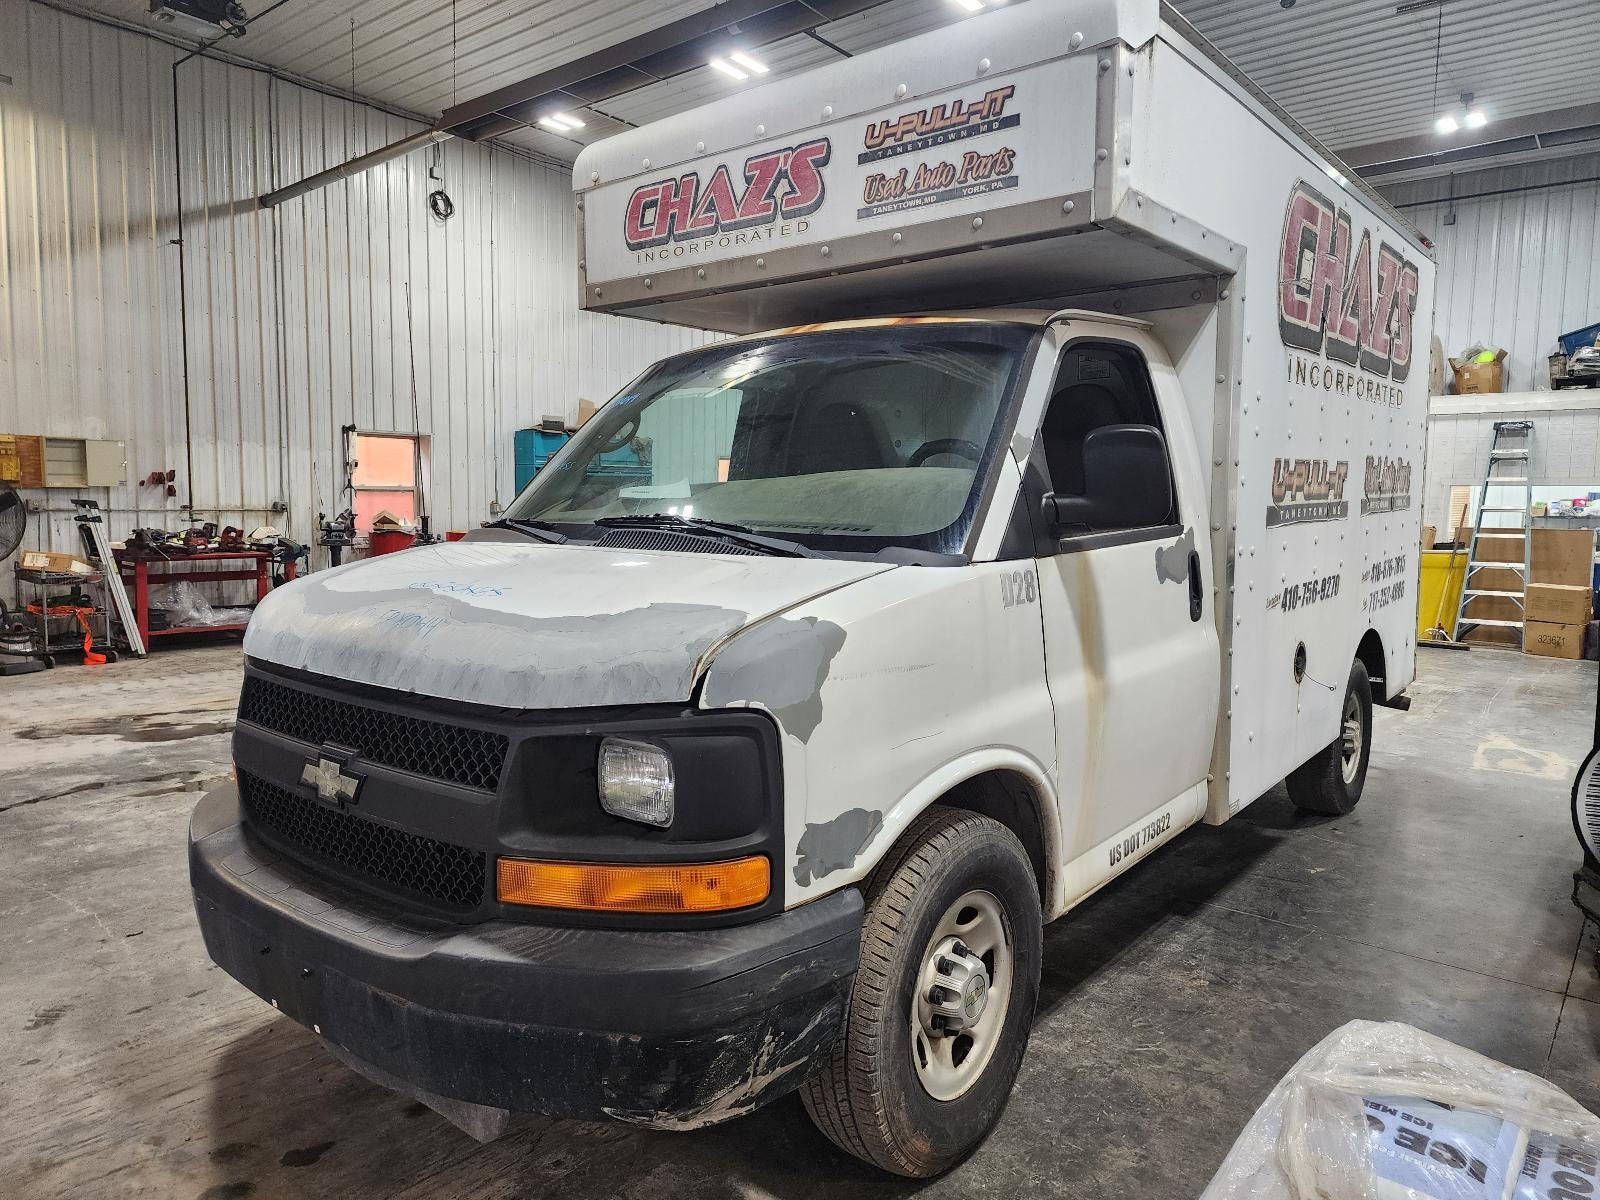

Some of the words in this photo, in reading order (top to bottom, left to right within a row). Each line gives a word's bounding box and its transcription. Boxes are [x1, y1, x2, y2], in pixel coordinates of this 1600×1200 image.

[864, 84, 1015, 149] U-PULL-IT
[980, 121, 1000, 133] MD
[624, 137, 831, 250] CHAZ'S
[864, 168, 908, 204] Used
[908, 162, 956, 193] Auto
[957, 147, 1016, 183] Parts
[991, 182, 1003, 191] PA
[637, 221, 810, 264] INCORPORATED
[1287, 354, 1403, 409] INCORPORATED
[1000, 569, 1036, 609] D28
[1281, 574, 1340, 612] 410-756-9270
[1109, 844, 1121, 867] US
[1124, 832, 1141, 858] DOT
[1142, 812, 1170, 846] 773822
[1400, 1112, 1434, 1131] ICE
[1394, 1125, 1488, 1184] ICE
